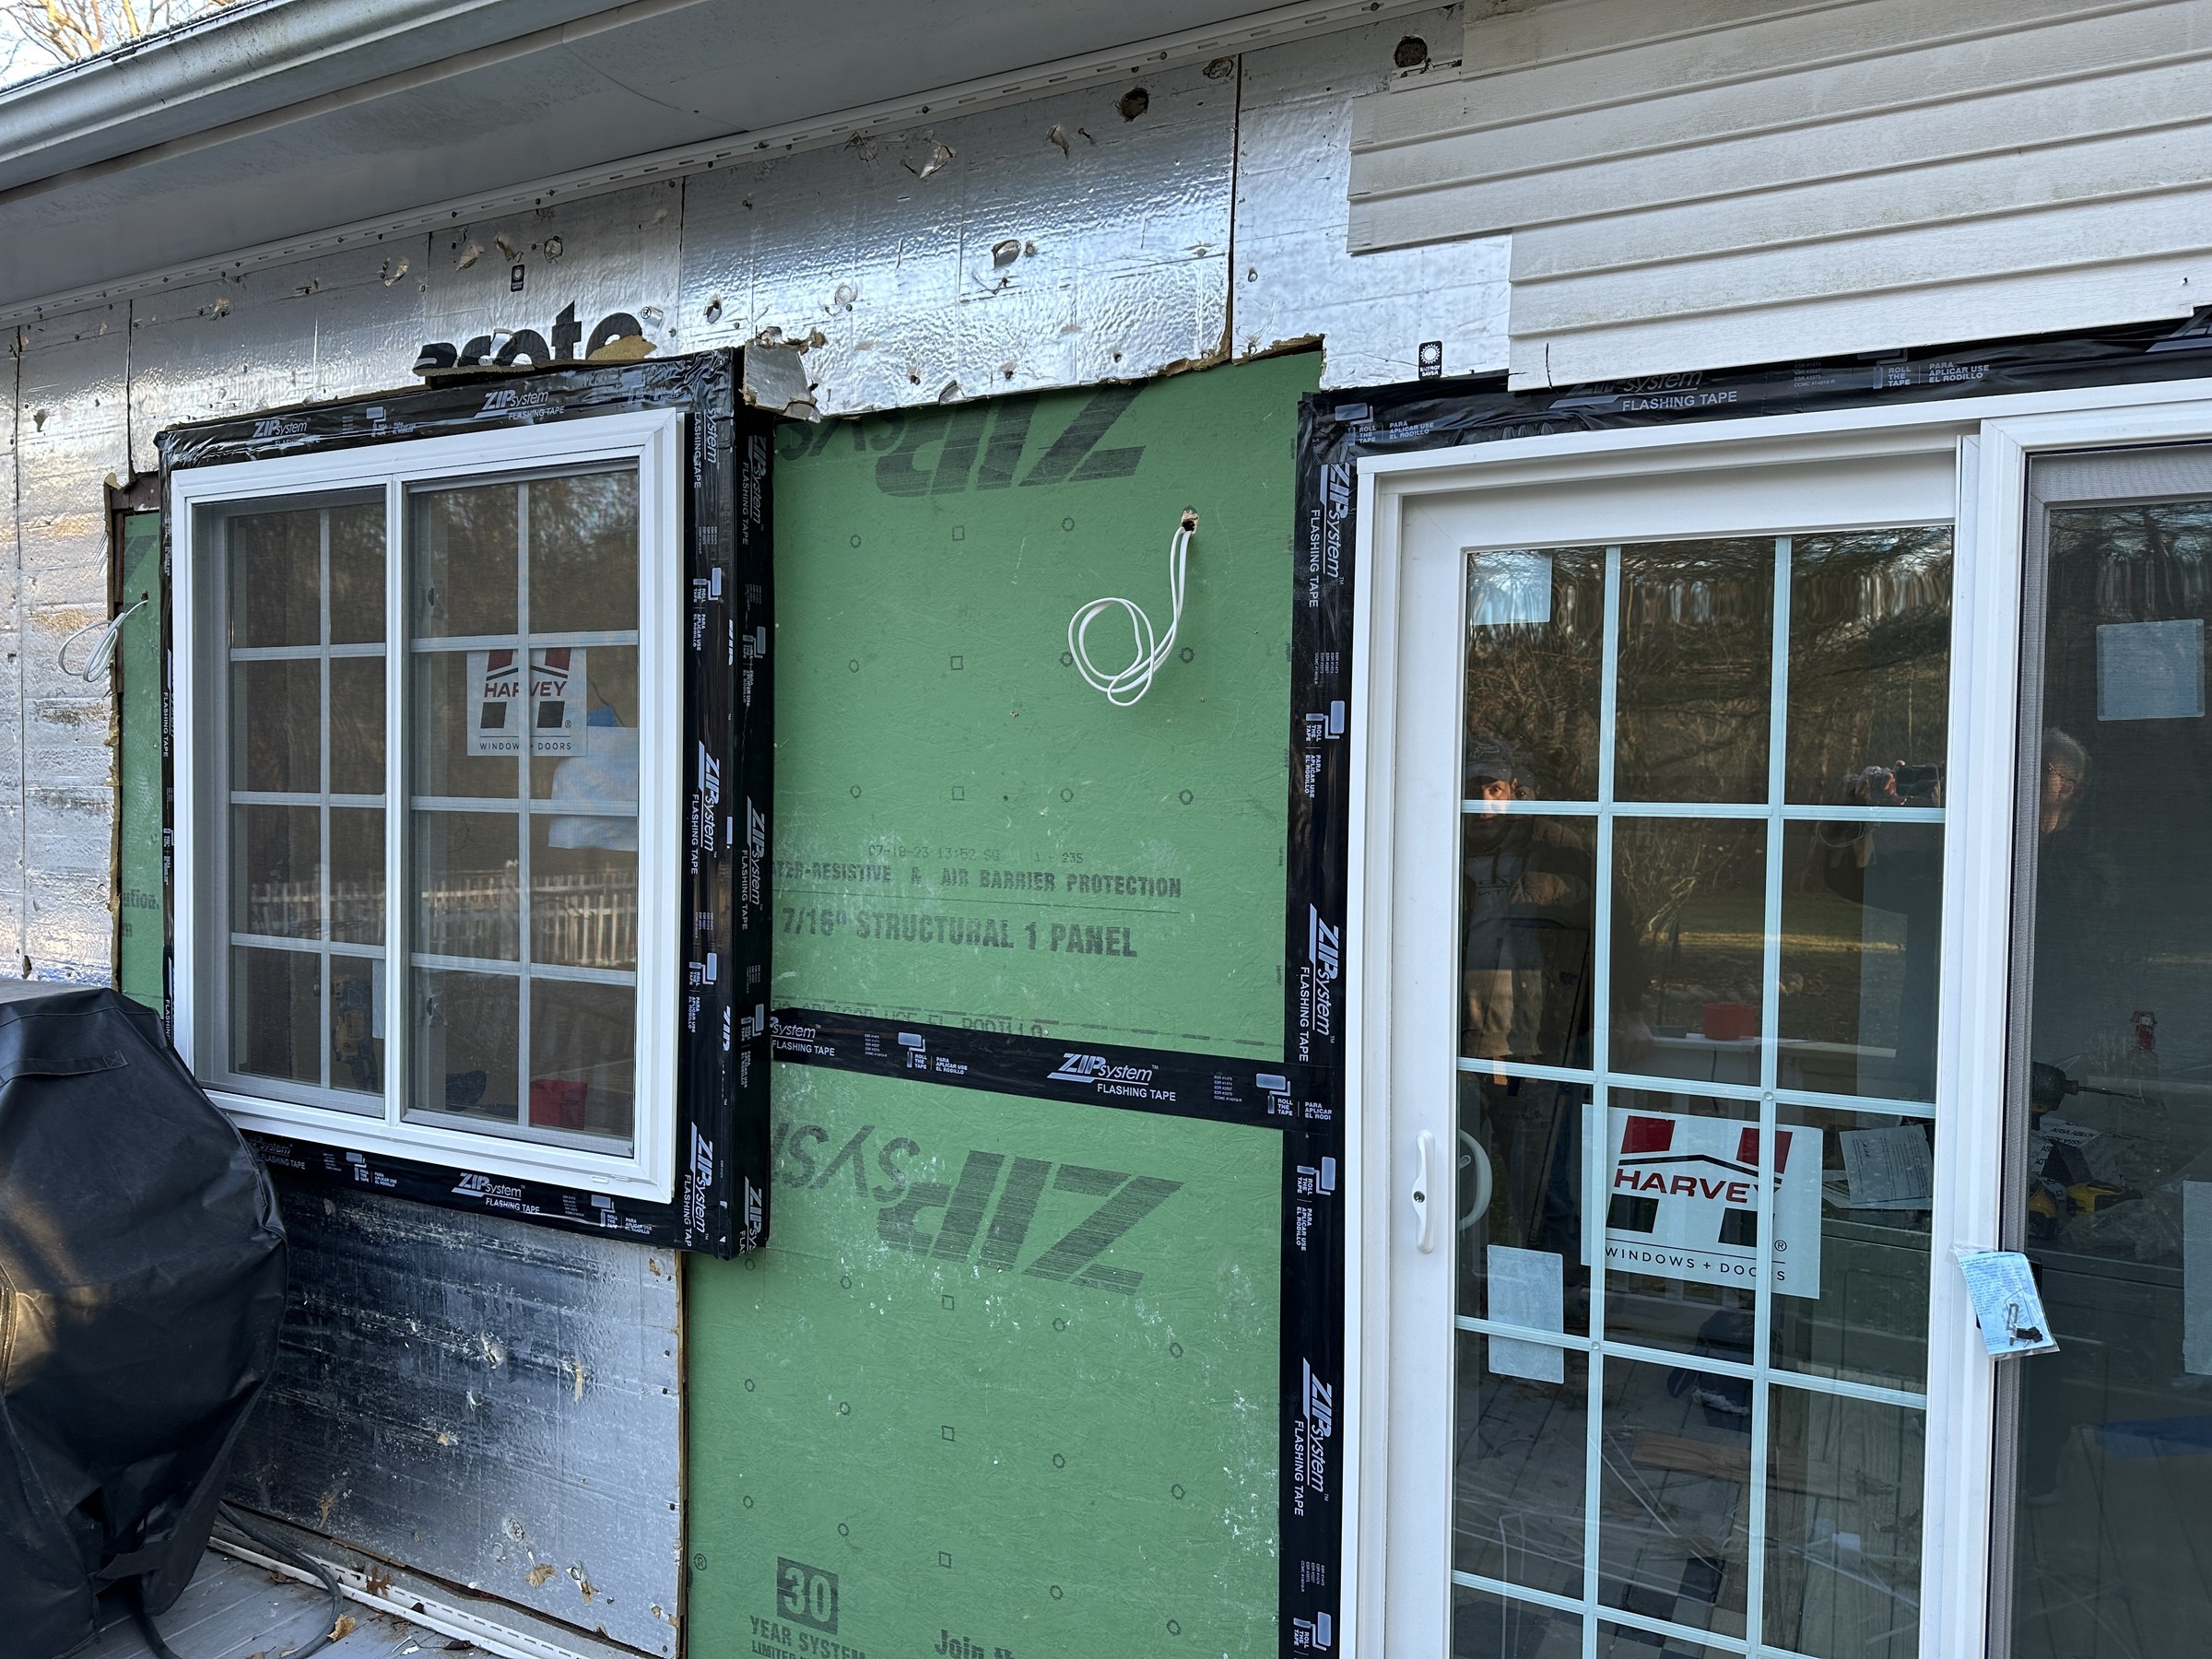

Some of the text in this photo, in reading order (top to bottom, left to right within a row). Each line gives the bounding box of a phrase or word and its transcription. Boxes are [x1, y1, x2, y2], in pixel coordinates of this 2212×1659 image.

[1928, 364, 1990, 377] APLICAR USE
[1929, 361, 1954, 370] PARA
[1888, 379, 1911, 387] TAPE
[1943, 372, 1983, 382] RODILLO
[1622, 391, 1737, 411] FLASHING TAPE
[508, 406, 565, 420] FLASHING TAPE
[1389, 420, 1408, 429] PARA
[1389, 424, 1419, 434] APLICAR
[1399, 429, 1430, 439] RODILLO
[1309, 509, 1320, 608] FLASHING TAPE
[537, 742, 571, 750] DOORS
[1305, 754, 1310, 763] EL
[690, 849, 699, 875] TAPE
[940, 867, 969, 888] AIR
[979, 869, 1055, 892] BARRIER
[1065, 873, 1182, 899] PROTECTION
[856, 910, 1014, 948] STRUCTURAL
[1023, 922, 1037, 950] 1
[1050, 922, 1138, 959] PANEL
[1299, 966, 1310, 1062] FLASHING TAPE
[771, 1040, 835, 1057] FLASHING TAPE
[1097, 1083, 1176, 1102] FLASHING TAPE
[1277, 1098, 1293, 1106] ROLL
[1304, 1107, 1333, 1115] APLICAR
[261, 1154, 306, 1170] FLASHING TAPE
[485, 1197, 540, 1214] FLASHING TAPE
[683, 1174, 691, 1225] FLASHING
[1296, 1206, 1301, 1216] EL
[1605, 1246, 1696, 1269] WINDOWS
[1720, 1263, 1786, 1281] DOOS
[1294, 1419, 1304, 1516] FLASHING TAPE
[783, 1565, 831, 1623] 30
[748, 1614, 793, 1647] YEAR
